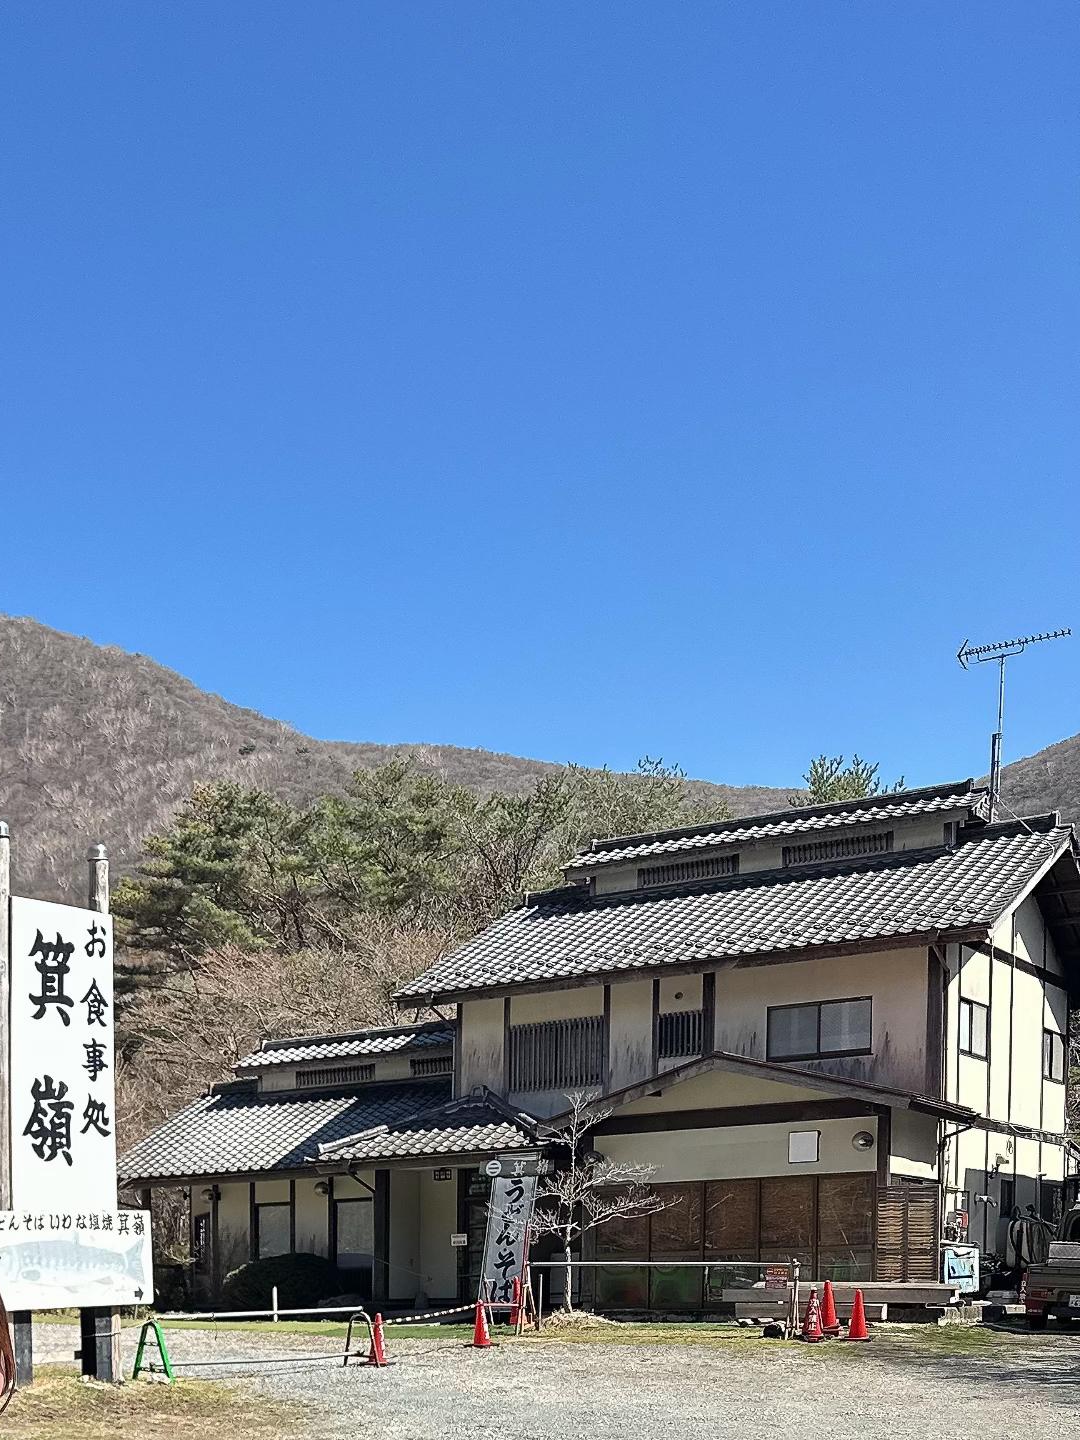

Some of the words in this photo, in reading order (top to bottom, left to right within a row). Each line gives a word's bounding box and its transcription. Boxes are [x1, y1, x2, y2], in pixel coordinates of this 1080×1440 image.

[22, 928, 75, 1167] 箕嶺
[79, 919, 112, 1138] お食事処
